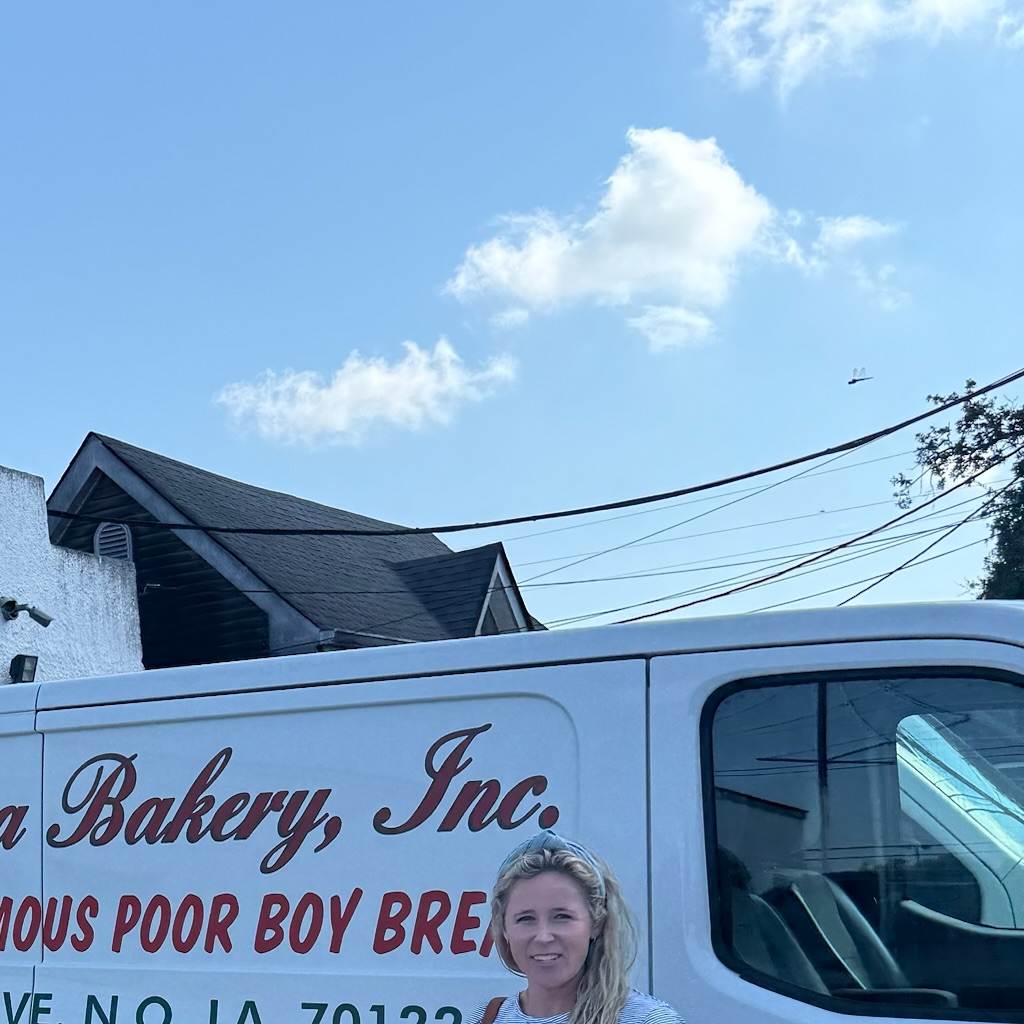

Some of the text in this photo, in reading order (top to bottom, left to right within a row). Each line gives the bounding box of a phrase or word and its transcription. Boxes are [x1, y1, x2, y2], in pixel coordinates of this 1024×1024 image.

[46, 746, 343, 875] Bakery,
[372, 722, 561, 834] Inc.
[111, 893, 240, 955] POOR
[253, 887, 364, 955] BOY
